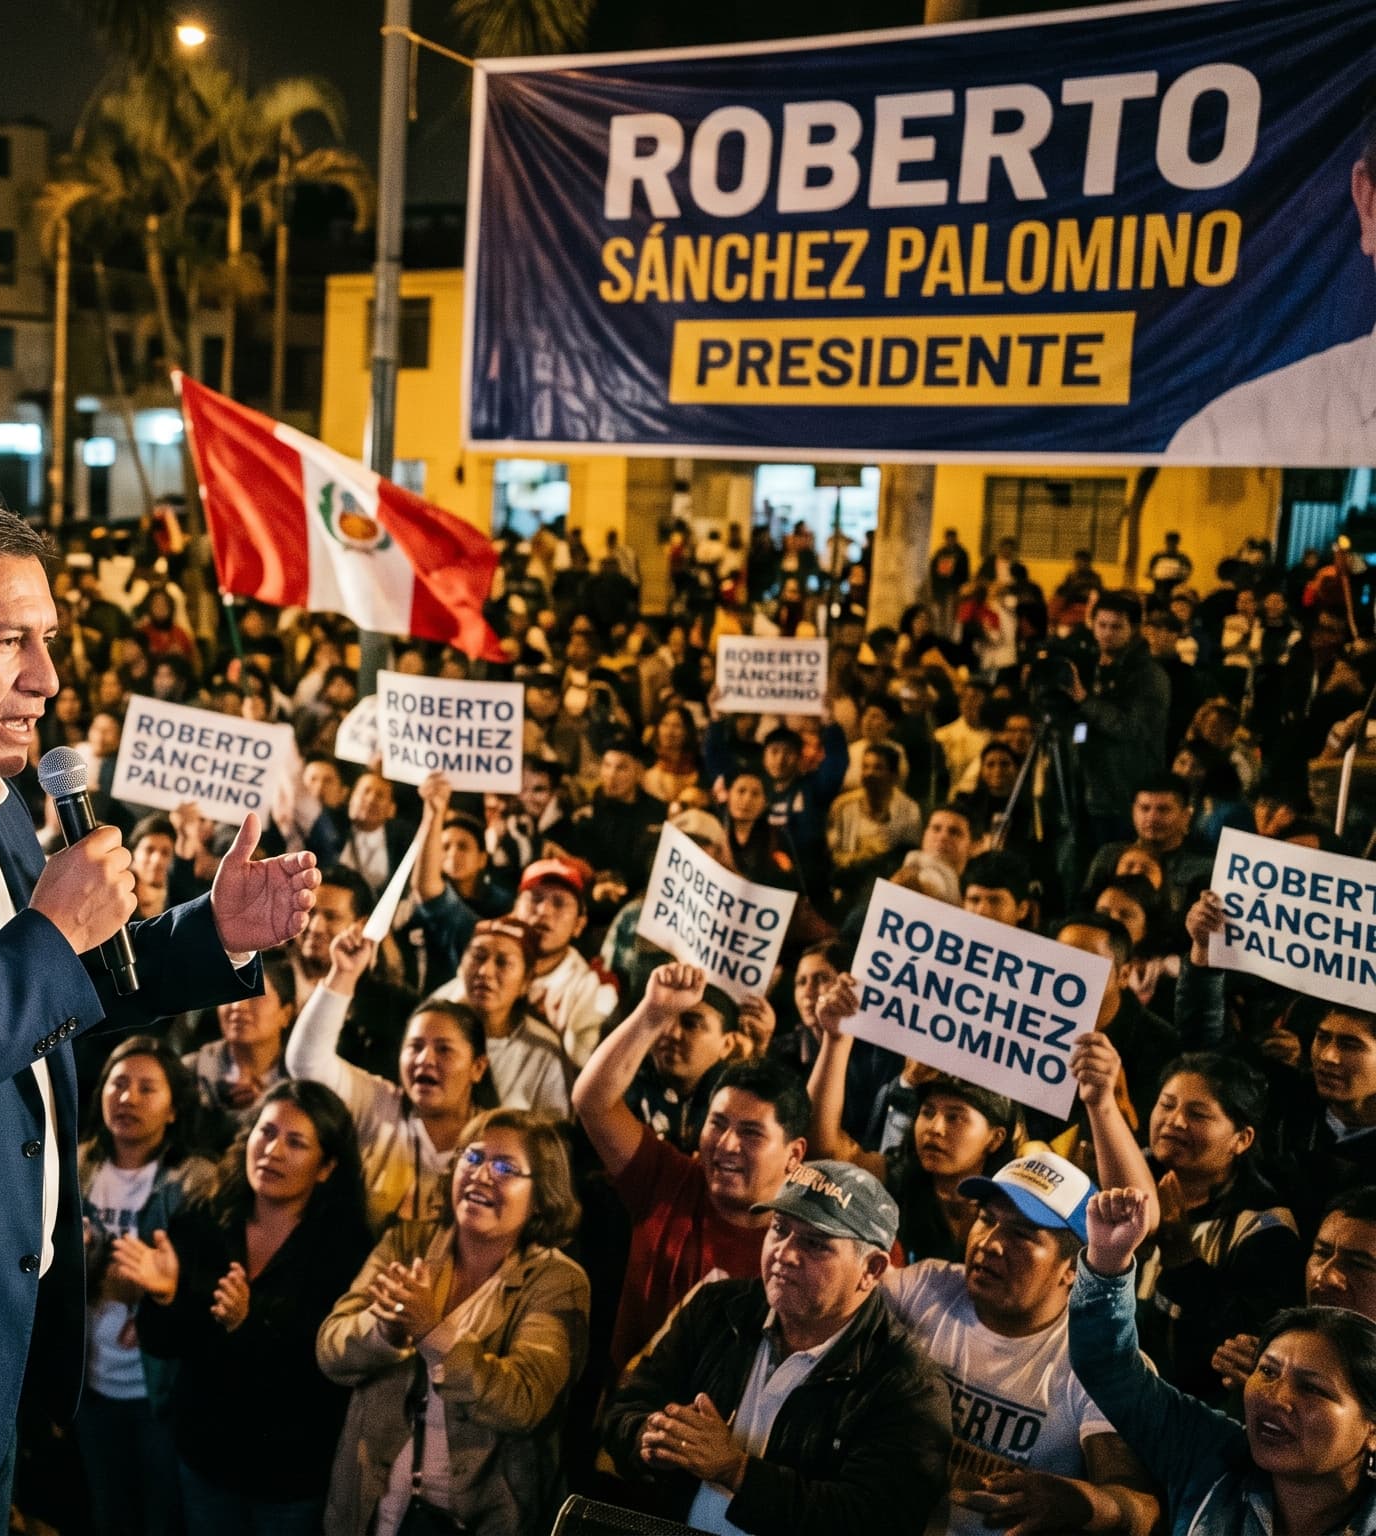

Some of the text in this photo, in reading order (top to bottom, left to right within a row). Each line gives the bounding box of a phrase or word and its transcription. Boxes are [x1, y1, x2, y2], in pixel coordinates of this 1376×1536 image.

[604, 62, 1262, 220] ROBERTO
[599, 210, 1242, 303] SÁNCHEZ PALOMINO
[696, 332, 1105, 387] PRESIDENTE
[726, 649, 820, 665] ROBERTO
[387, 690, 514, 721] ROBERTO
[724, 687, 820, 699] PALOMINO
[137, 714, 272, 760] ROBERTO
[390, 743, 513, 774] PALOMINO
[127, 765, 261, 809] PALOMINO
[668, 847, 779, 931] ROBERTO
[654, 903, 762, 987] PALOMINO
[877, 908, 1087, 1008] ROBERTO
[859, 985, 1067, 1085] PALOMINO
[867, 951, 1077, 1052] SÁNCHEZ
[949, 1383, 1041, 1452] ERTO
